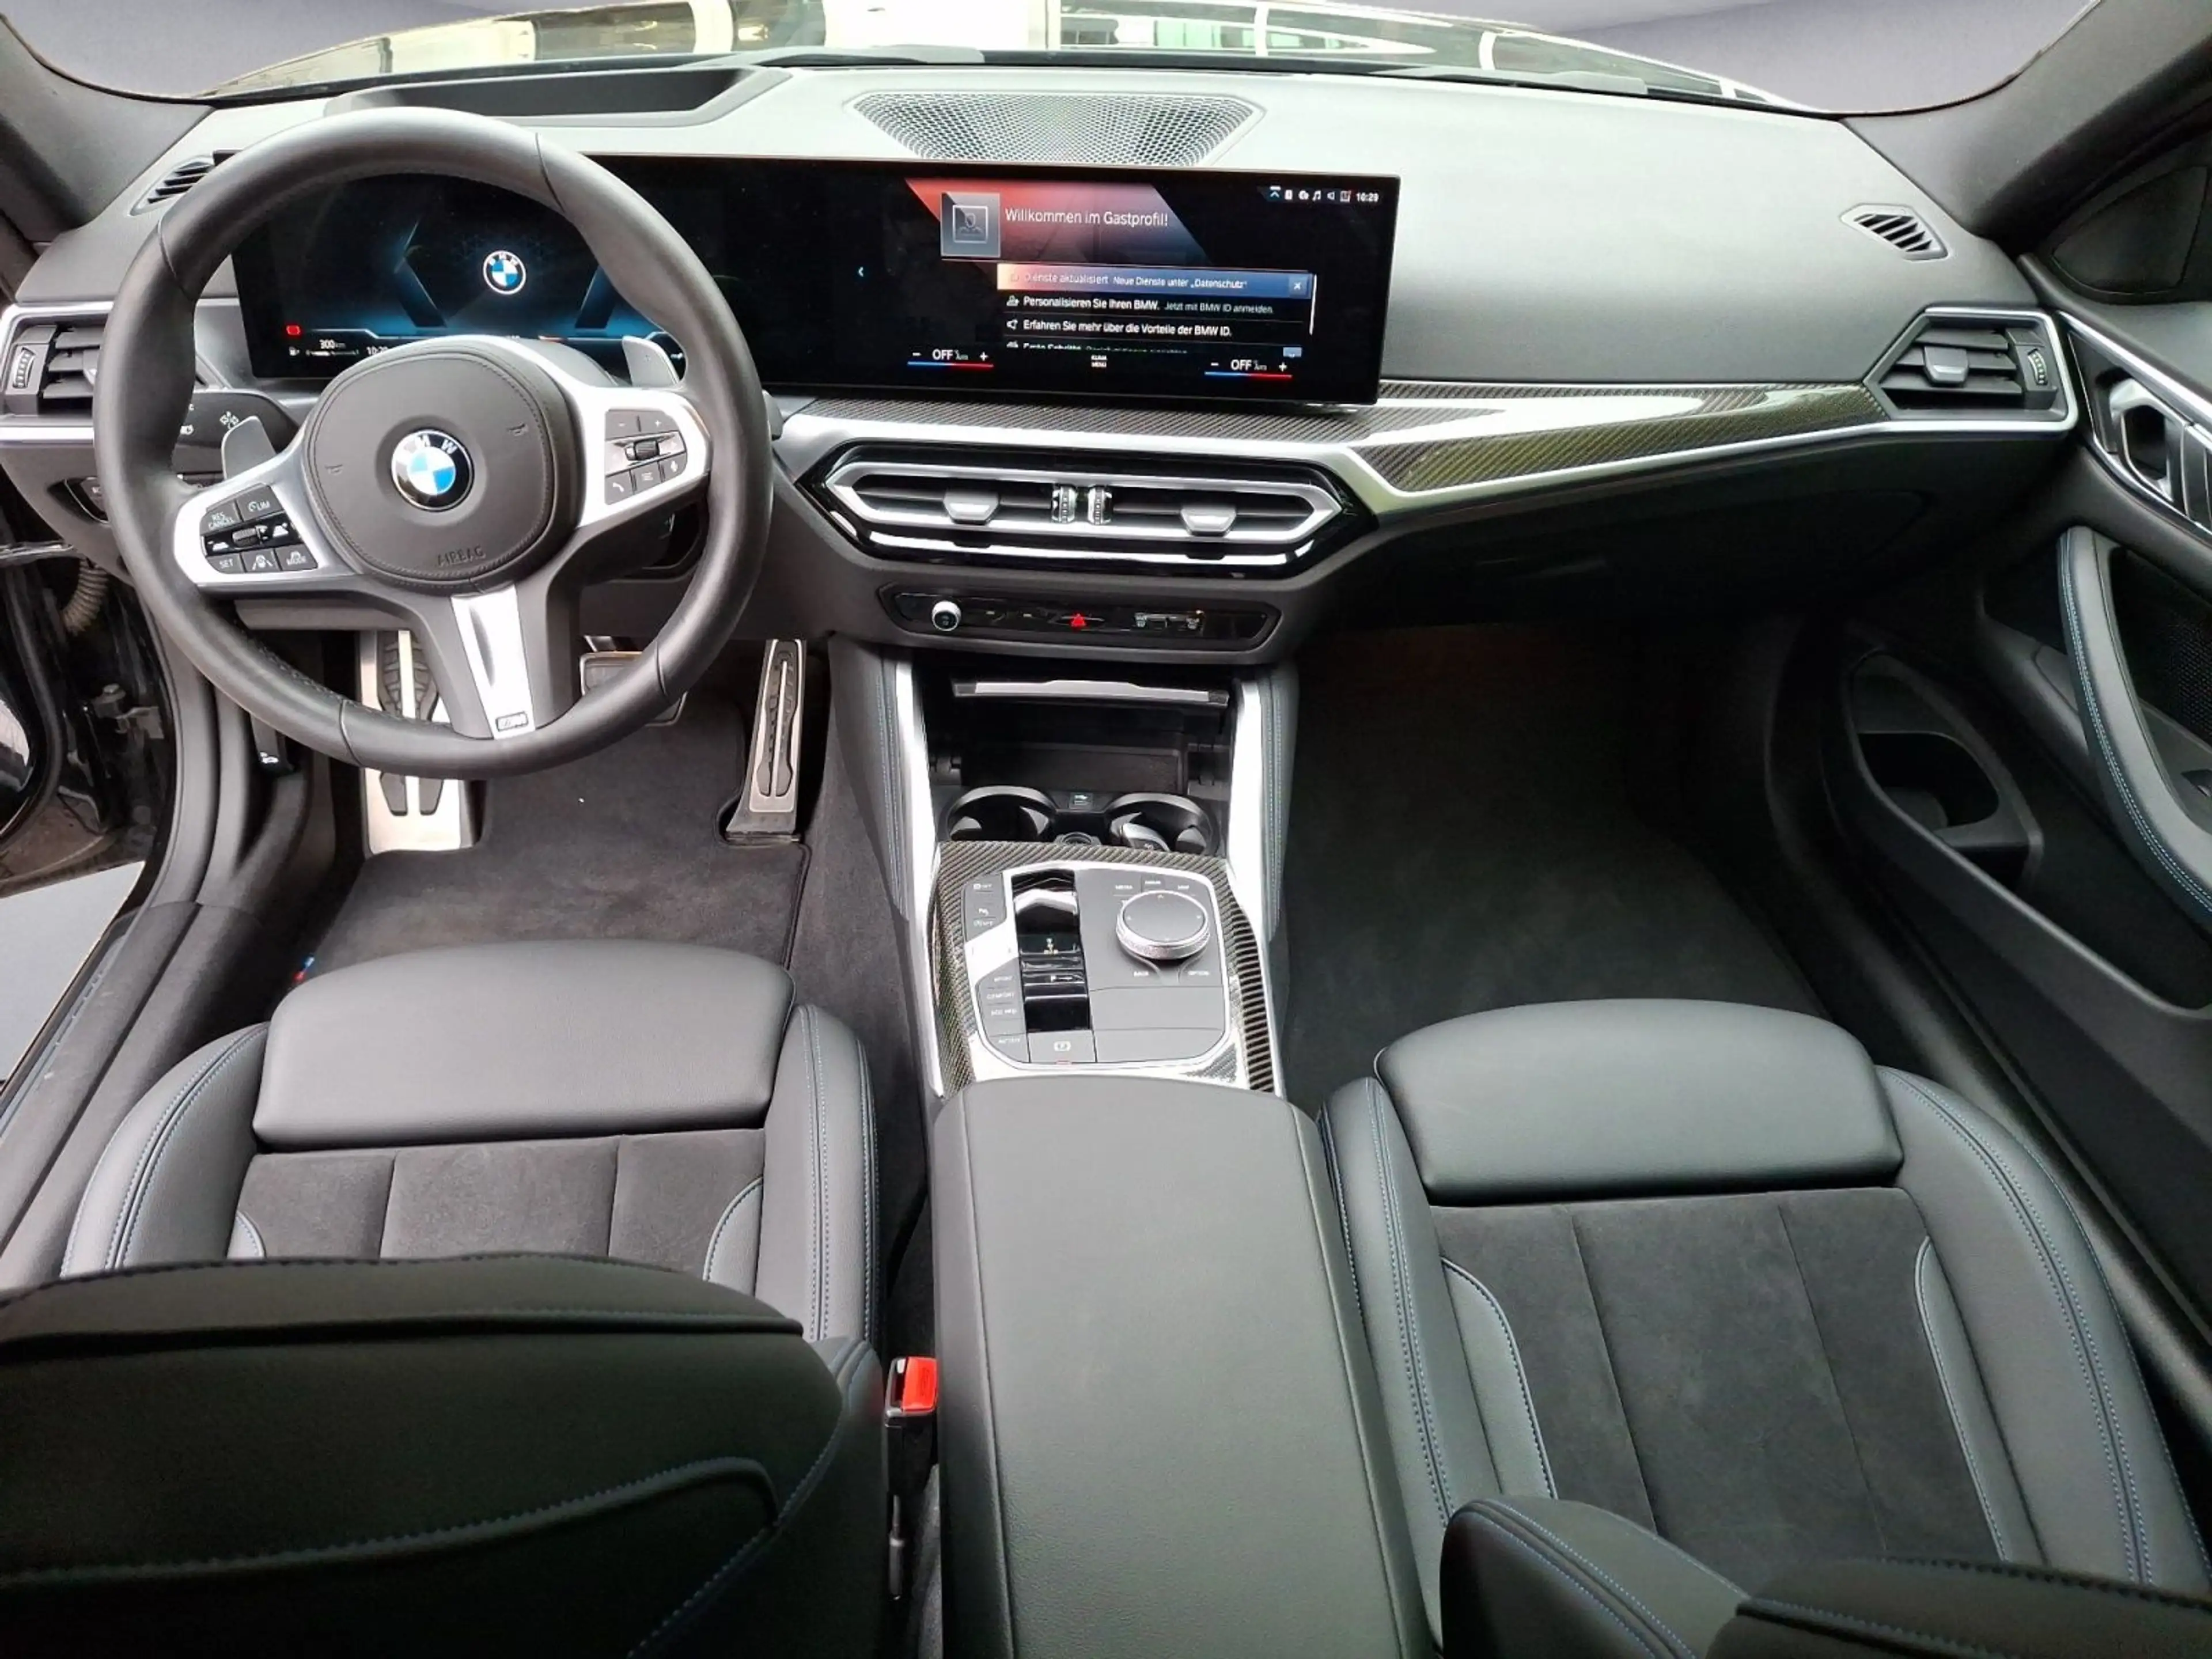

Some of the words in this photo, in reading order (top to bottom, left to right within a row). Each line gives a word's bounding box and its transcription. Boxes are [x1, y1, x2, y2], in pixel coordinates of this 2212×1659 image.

[1005, 208, 1082, 224] Willkommen
[1085, 211, 1100, 224] im
[1103, 211, 1168, 228] Gastprofil!
[1112, 276, 1134, 286] Neue
[1135, 276, 1166, 287] Dienste
[1167, 279, 1189, 287] unter
[1023, 295, 1092, 308] Personalisieren
[1093, 298, 1107, 309] Sie
[1109, 299, 1132, 309] Ihren
[1134, 300, 1160, 310] BMW.
[1164, 302, 1184, 311] Jetzt
[1185, 303, 1198, 311] mit
[1200, 303, 1220, 312] BMW
[1222, 304, 1232, 312] ID
[1023, 319, 1061, 331] Erfahren
[1063, 320, 1077, 331] Sie
[1078, 322, 1101, 332] mehr
[1103, 321, 1123, 333] über
[1126, 322, 1139, 334] die
[1141, 323, 1175, 335] Vorteile
[1177, 325, 1192, 335] der
[1194, 325, 1218, 336] BMW
[932, 349, 953, 361] OFF
[1230, 359, 1252, 371] OFF
[219, 558, 233, 569] SET
